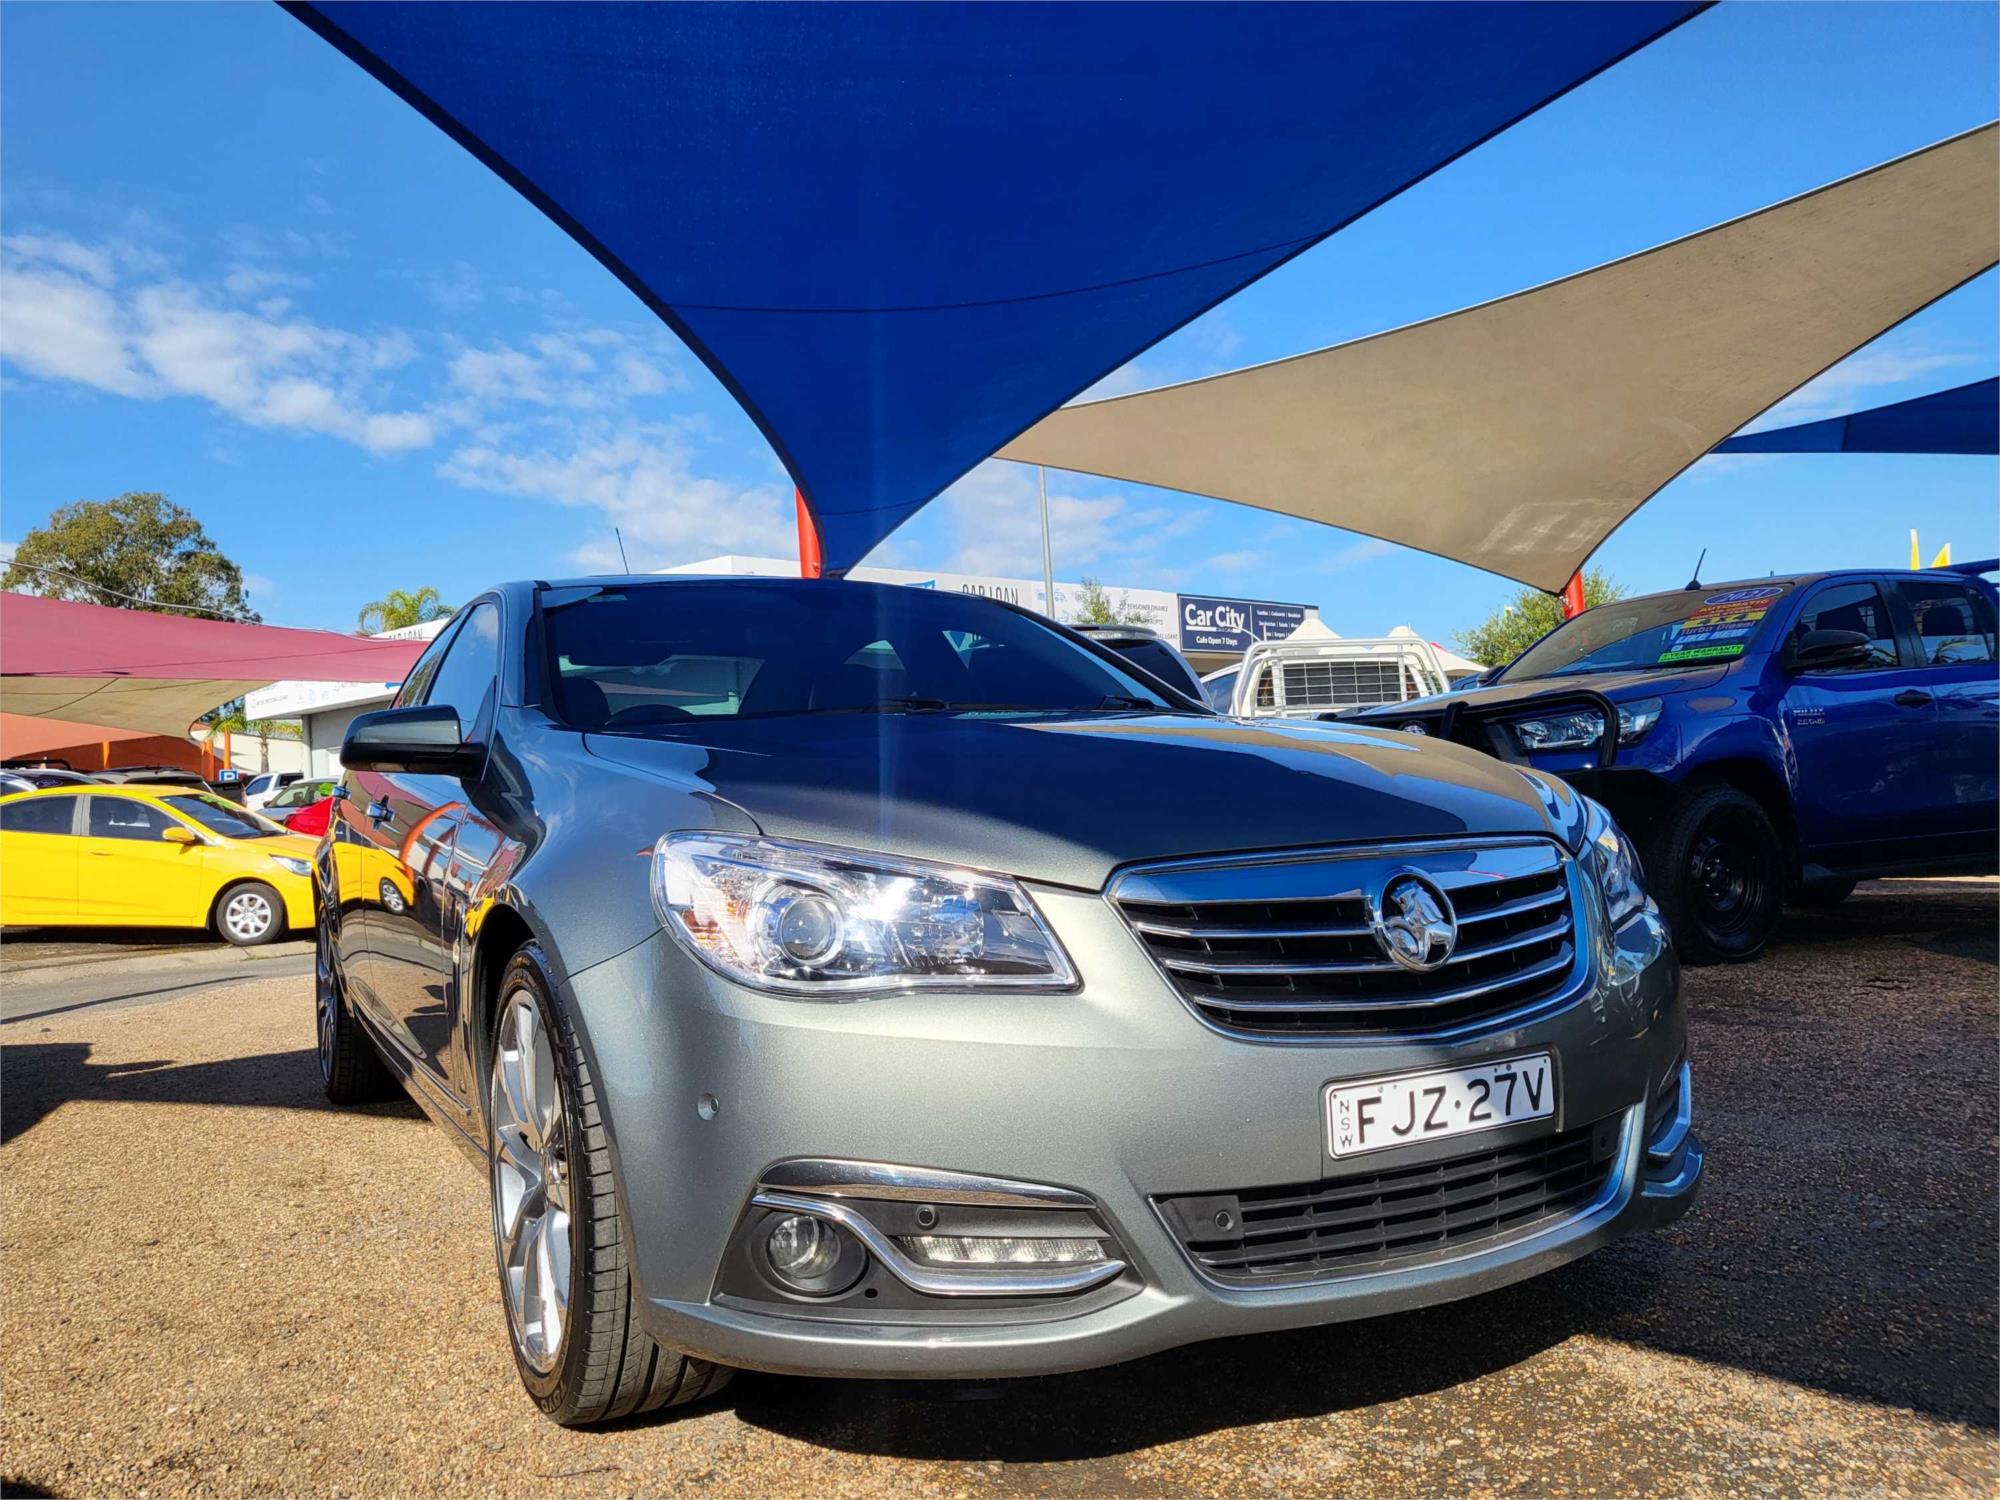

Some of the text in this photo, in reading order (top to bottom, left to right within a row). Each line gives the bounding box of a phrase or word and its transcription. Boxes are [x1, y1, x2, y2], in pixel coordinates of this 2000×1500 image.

[1185, 603, 1212, 626] Car
[1215, 606, 1245, 630] City
[1196, 635, 1238, 646] Cafe Open 7 Days
